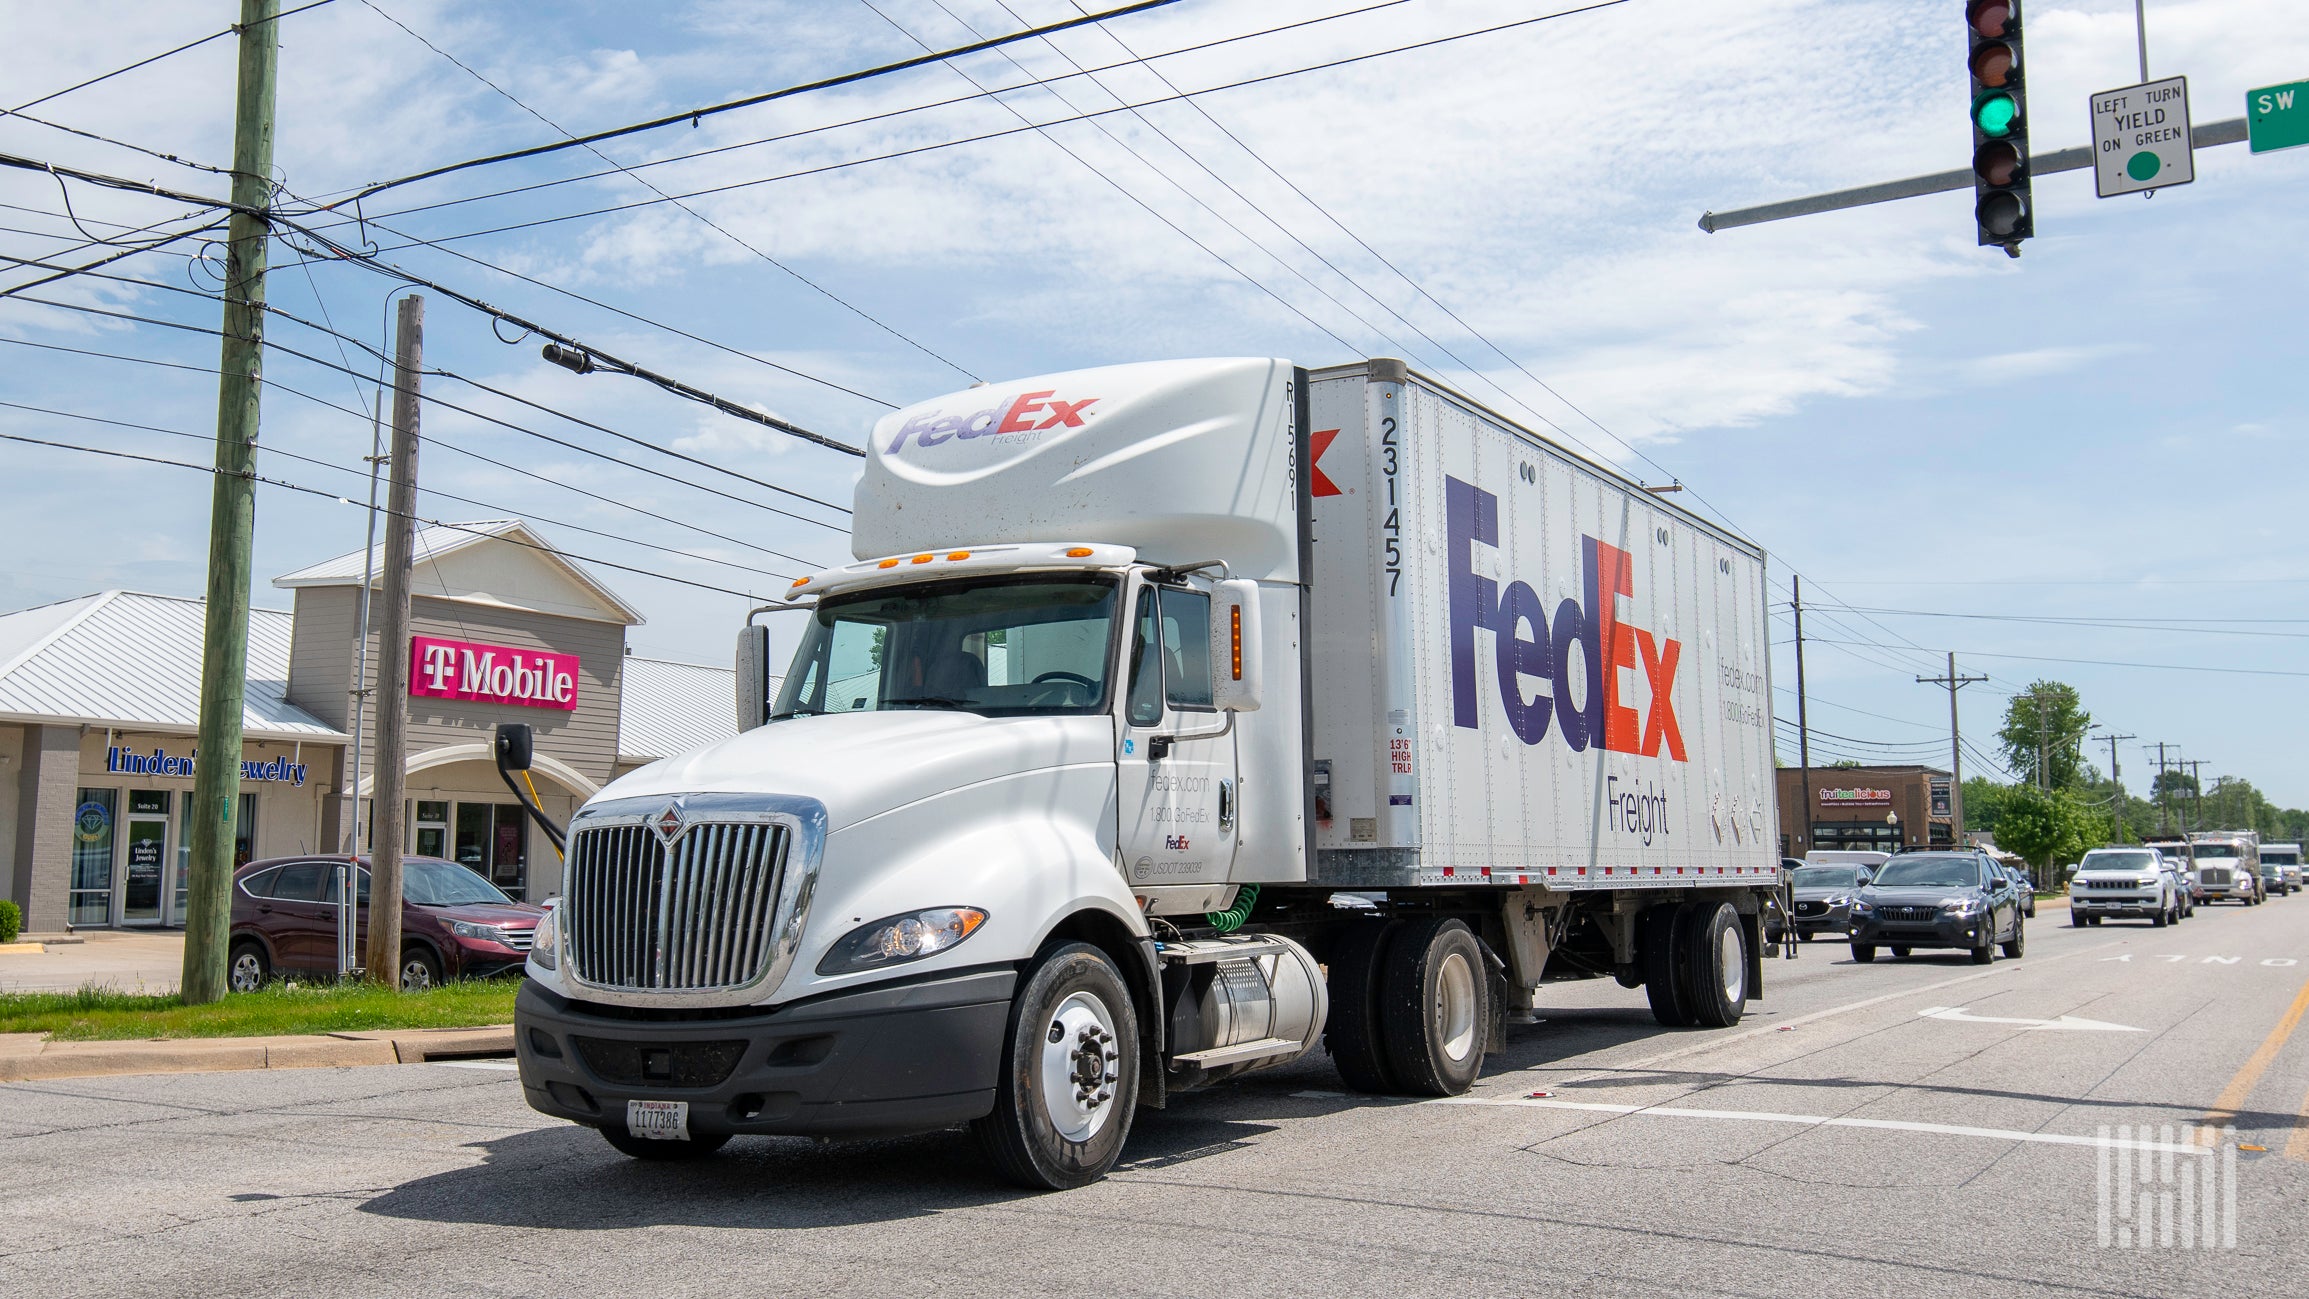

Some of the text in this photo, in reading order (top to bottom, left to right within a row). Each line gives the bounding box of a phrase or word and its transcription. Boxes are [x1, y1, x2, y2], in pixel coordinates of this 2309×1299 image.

[2096, 86, 2181, 114] LEFT TURN
[2257, 89, 2294, 114] SW
[2114, 108, 2166, 131] YIELD
[2102, 126, 2181, 152] ON GREEN
[883, 389, 1101, 455] FedEx
[991, 430, 1042, 447] Freight
[1381, 416, 1401, 597] 231457
[1445, 474, 1689, 763] FedEx
[1720, 656, 1764, 697] fedex.com
[1391, 751, 1412, 762] HIGH
[1392, 762, 1412, 774] TRLR
[239, 755, 309, 787] ewelry
[1150, 768, 1210, 793] fedex.com
[1819, 787, 1891, 800] fruitealicious
[1607, 775, 1669, 847] Freight
[1165, 834, 1190, 850] FedEx
[2097, 954, 2299, 968] ONLY
[635, 1110, 679, 1130] 1177386
